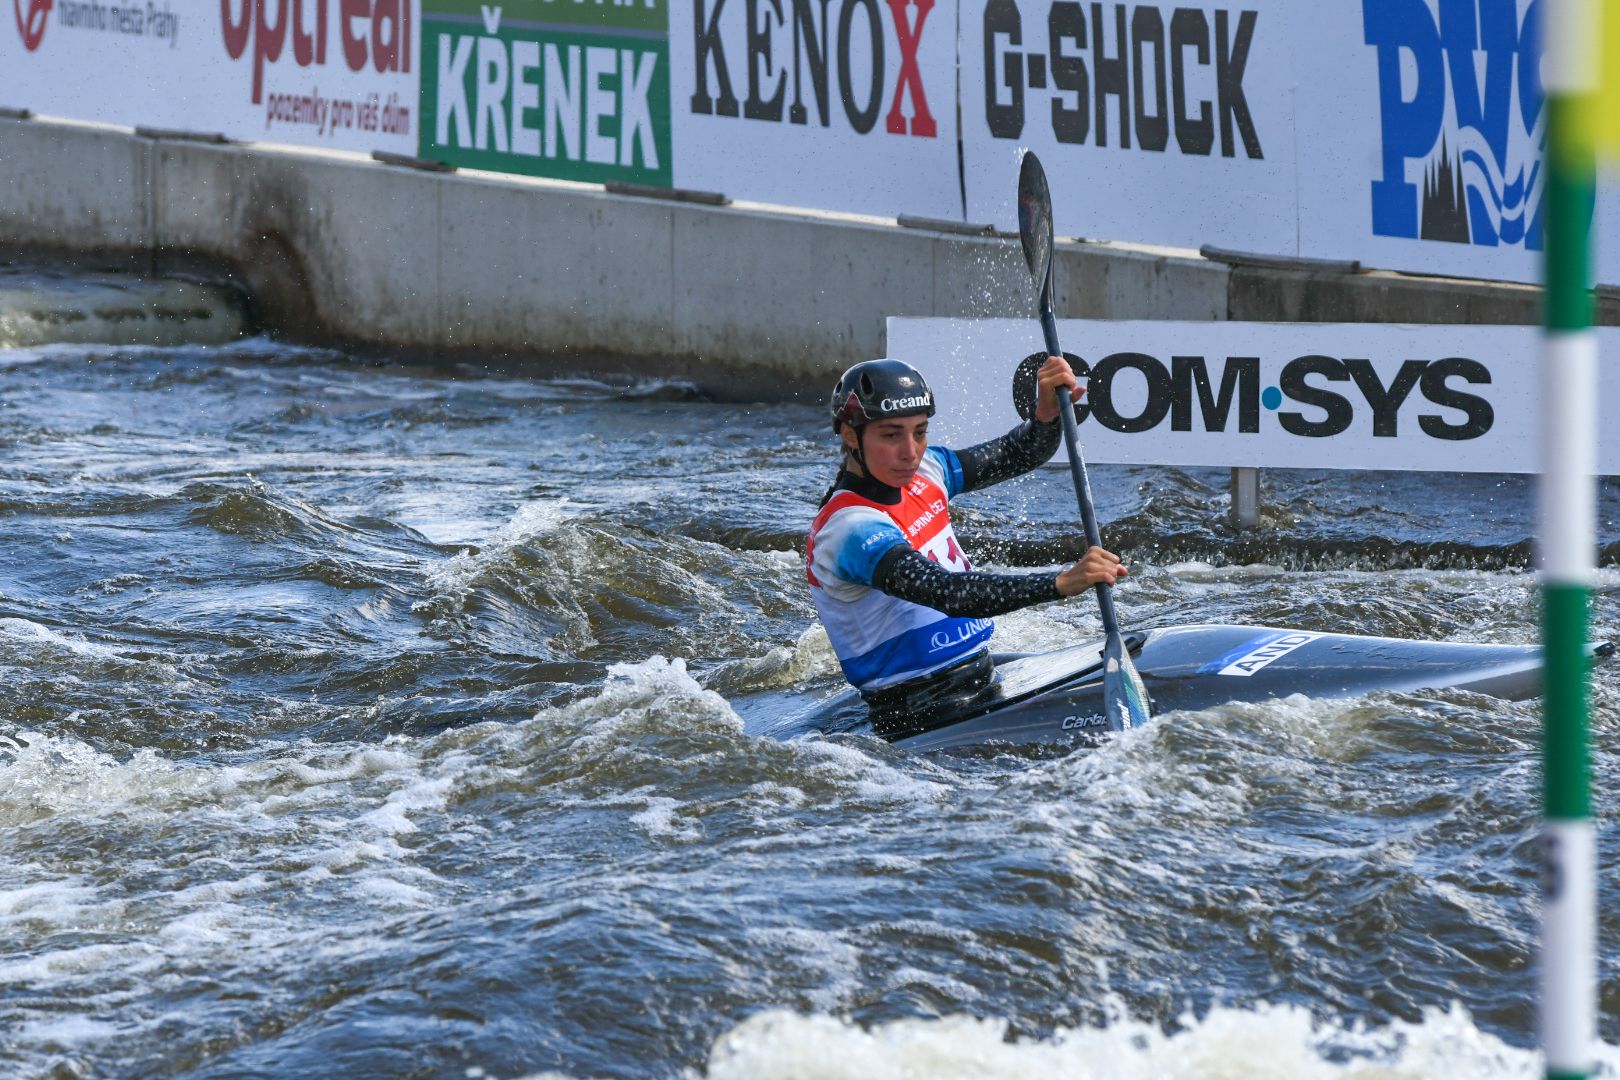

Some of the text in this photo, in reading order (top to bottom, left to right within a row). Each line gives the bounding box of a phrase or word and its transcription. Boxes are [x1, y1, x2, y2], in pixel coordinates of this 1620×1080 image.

[436, 5, 660, 171] KŘENEK
[690, 0, 938, 138] KENOX
[983, 0, 1264, 160] G-SHOCK
[265, 86, 329, 137] pozemky
[329, 99, 354, 138] pro
[880, 392, 932, 412] Creand
[928, 498, 946, 515] ČEZ
[1234, 635, 1312, 672] AND
